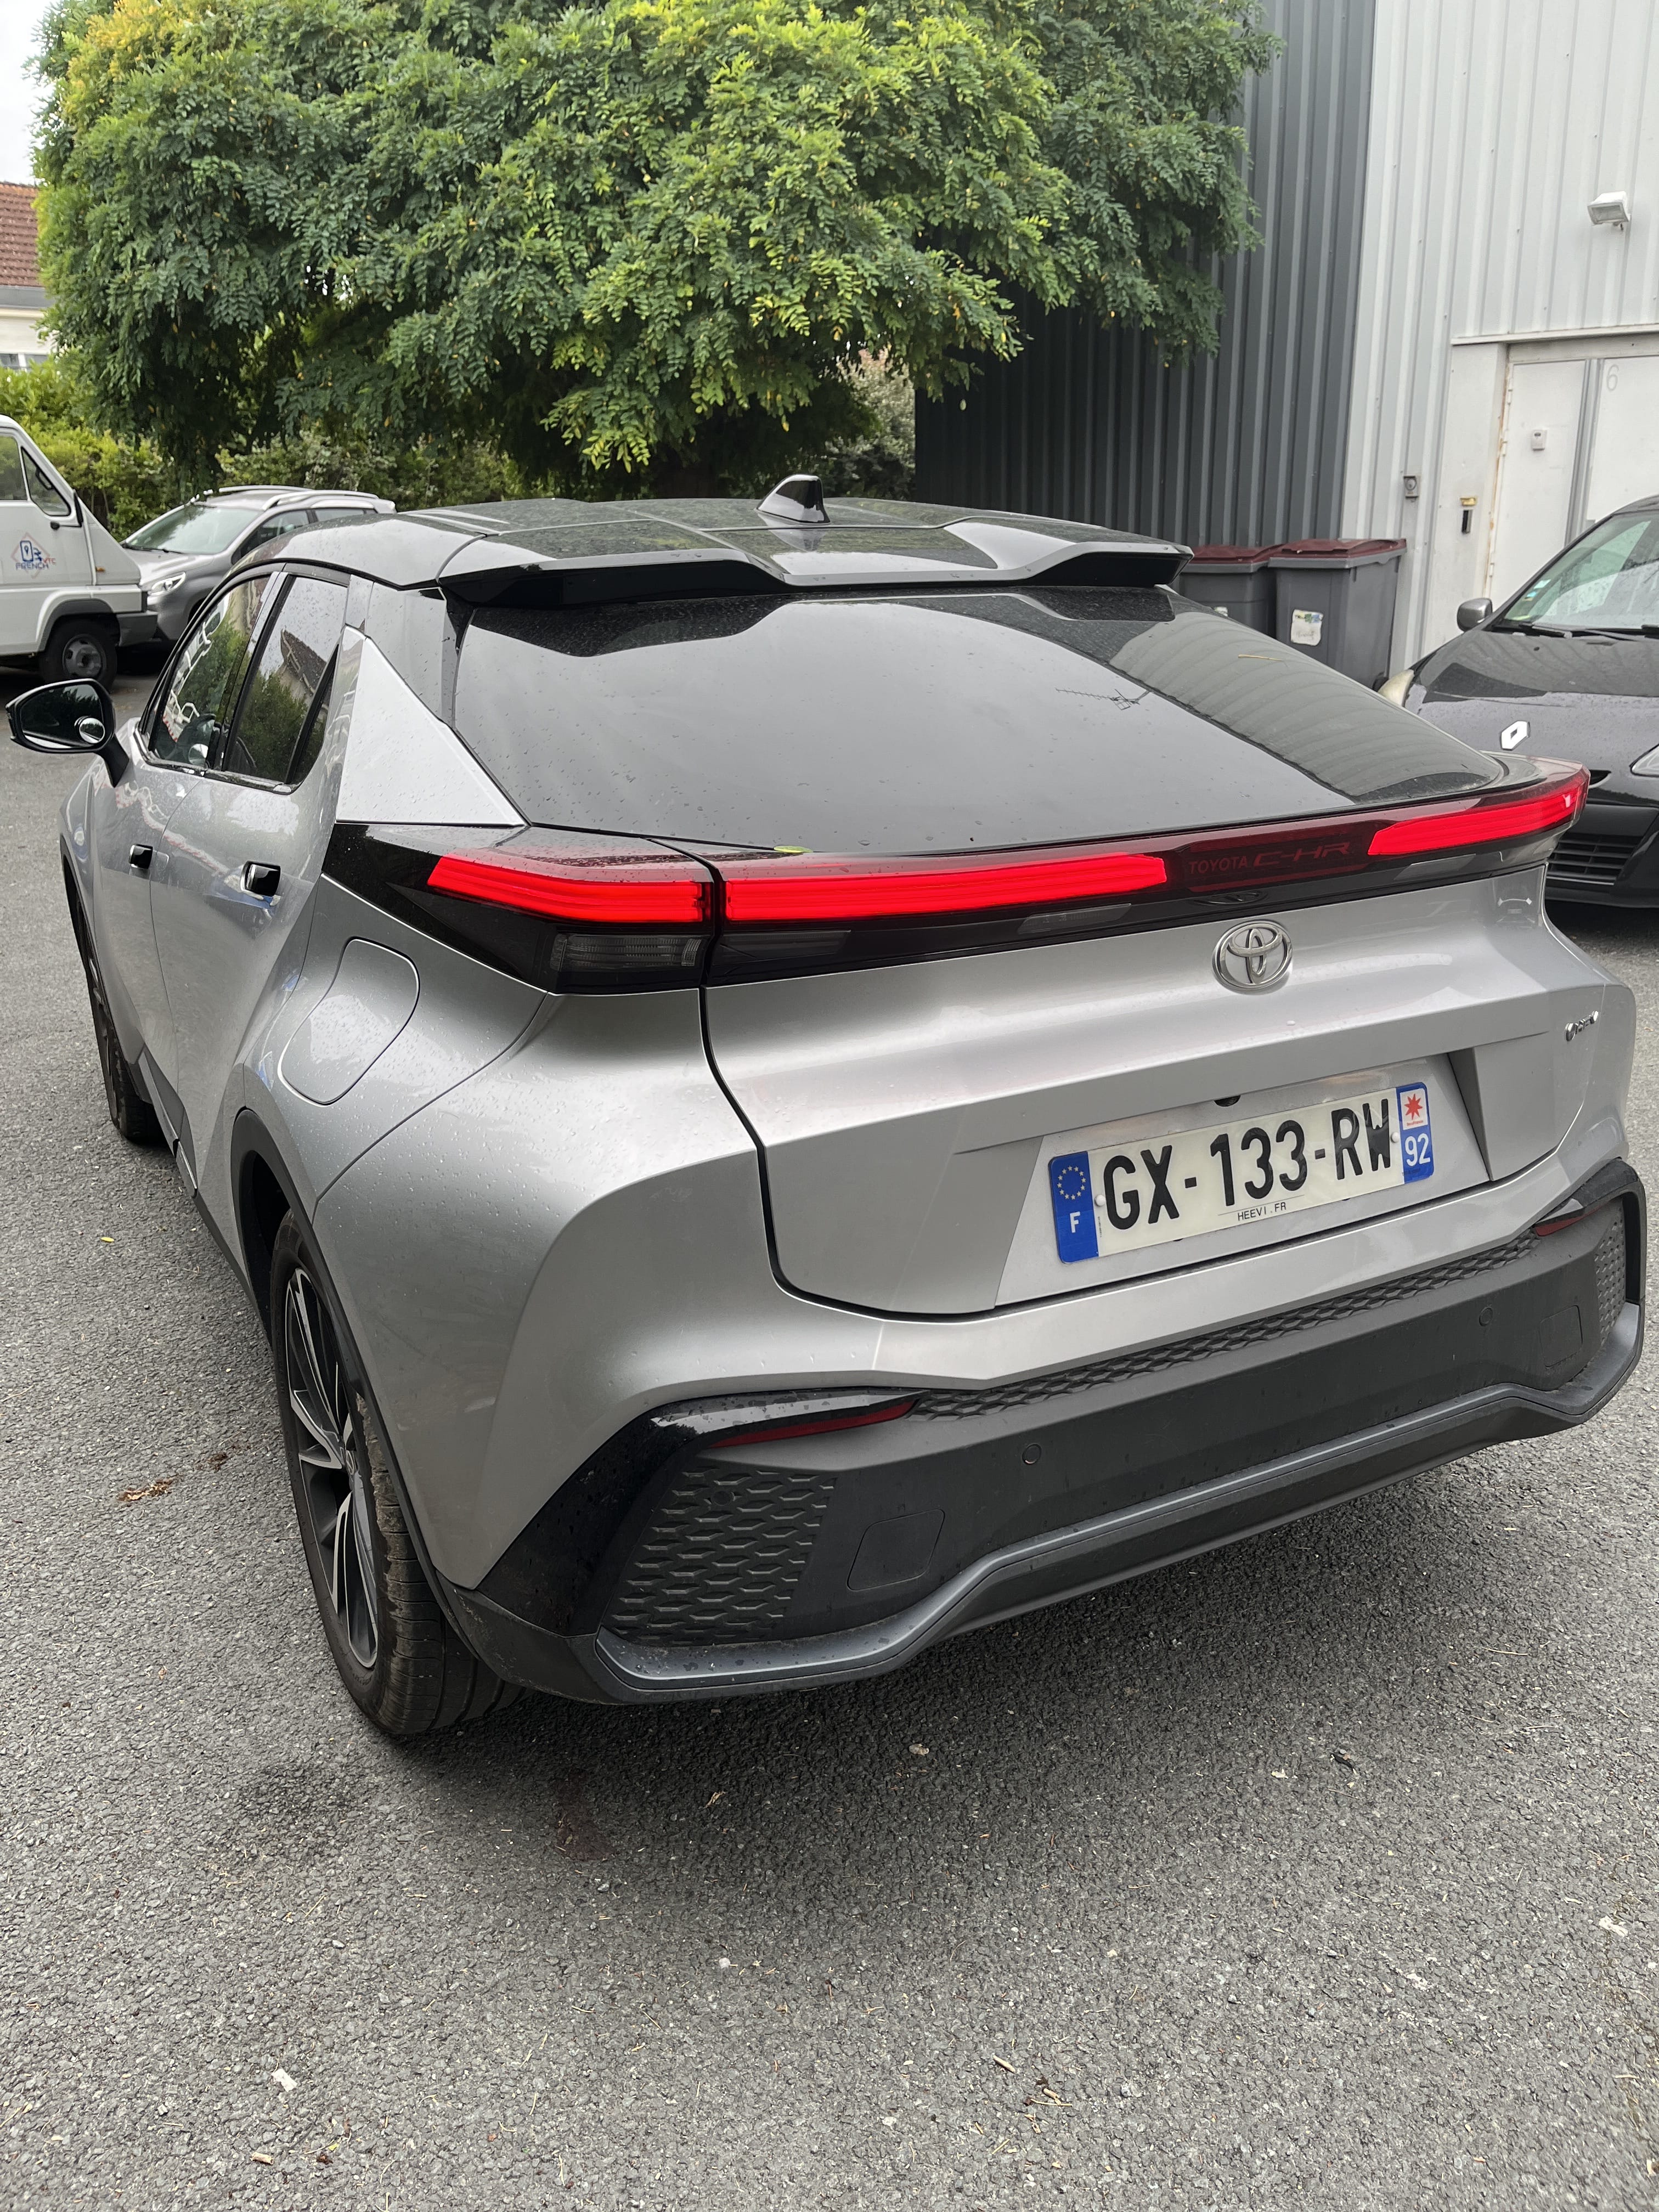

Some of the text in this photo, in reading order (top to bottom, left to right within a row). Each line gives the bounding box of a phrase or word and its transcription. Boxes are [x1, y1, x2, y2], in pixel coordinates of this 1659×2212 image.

[1606, 364, 1619, 392] 6
[15, 562, 49, 571] FRENCH
[1188, 842, 1350, 874] TOYOTA C-HR
[1103, 1098, 1391, 1230] GX-133-RW
[1404, 1133, 1431, 1166] 92
[1069, 1211, 1081, 1233] F
